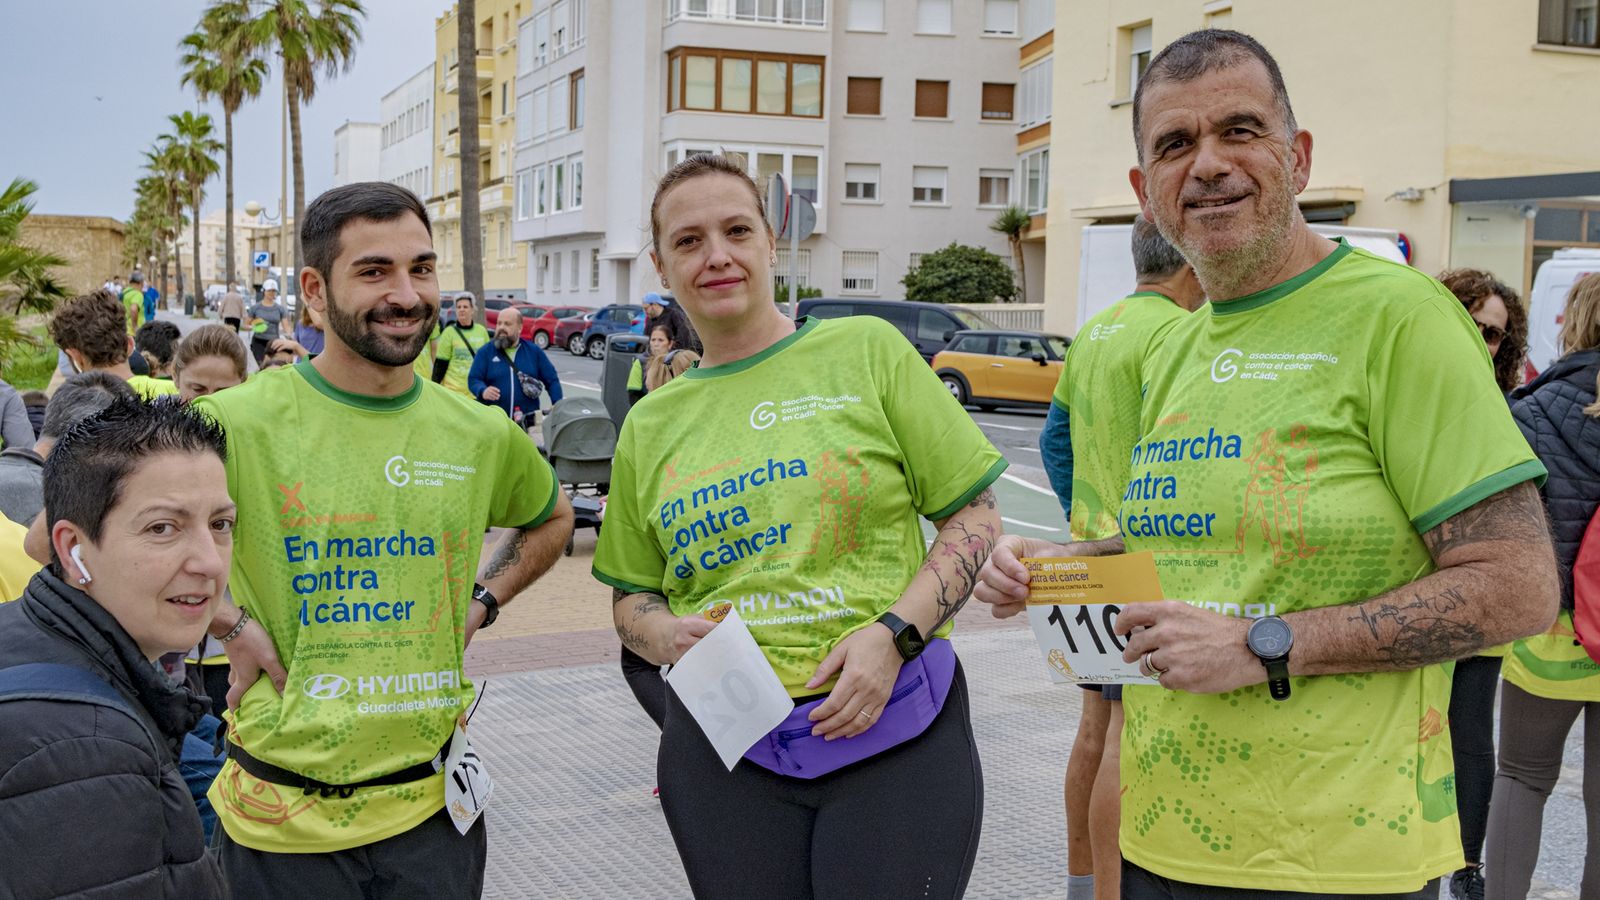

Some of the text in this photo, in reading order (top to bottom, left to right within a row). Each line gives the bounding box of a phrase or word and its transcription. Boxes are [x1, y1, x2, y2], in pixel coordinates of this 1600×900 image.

[1240, 372, 1252, 380] en
[1244, 361, 1273, 370] contra
[1274, 361, 1283, 370] el
[1131, 427, 1242, 466] n marcha
[660, 497, 685, 530] En
[692, 458, 808, 510] marcha
[1128, 506, 1216, 538] cáncer
[284, 528, 436, 563] En marcha
[700, 522, 792, 571] cáncer
[292, 564, 379, 595] contra
[1055, 560, 1088, 571] marcha
[314, 595, 416, 624] cáncer
[357, 670, 461, 696] HYUNDAI
[357, 696, 462, 715] Guadalete Motor
